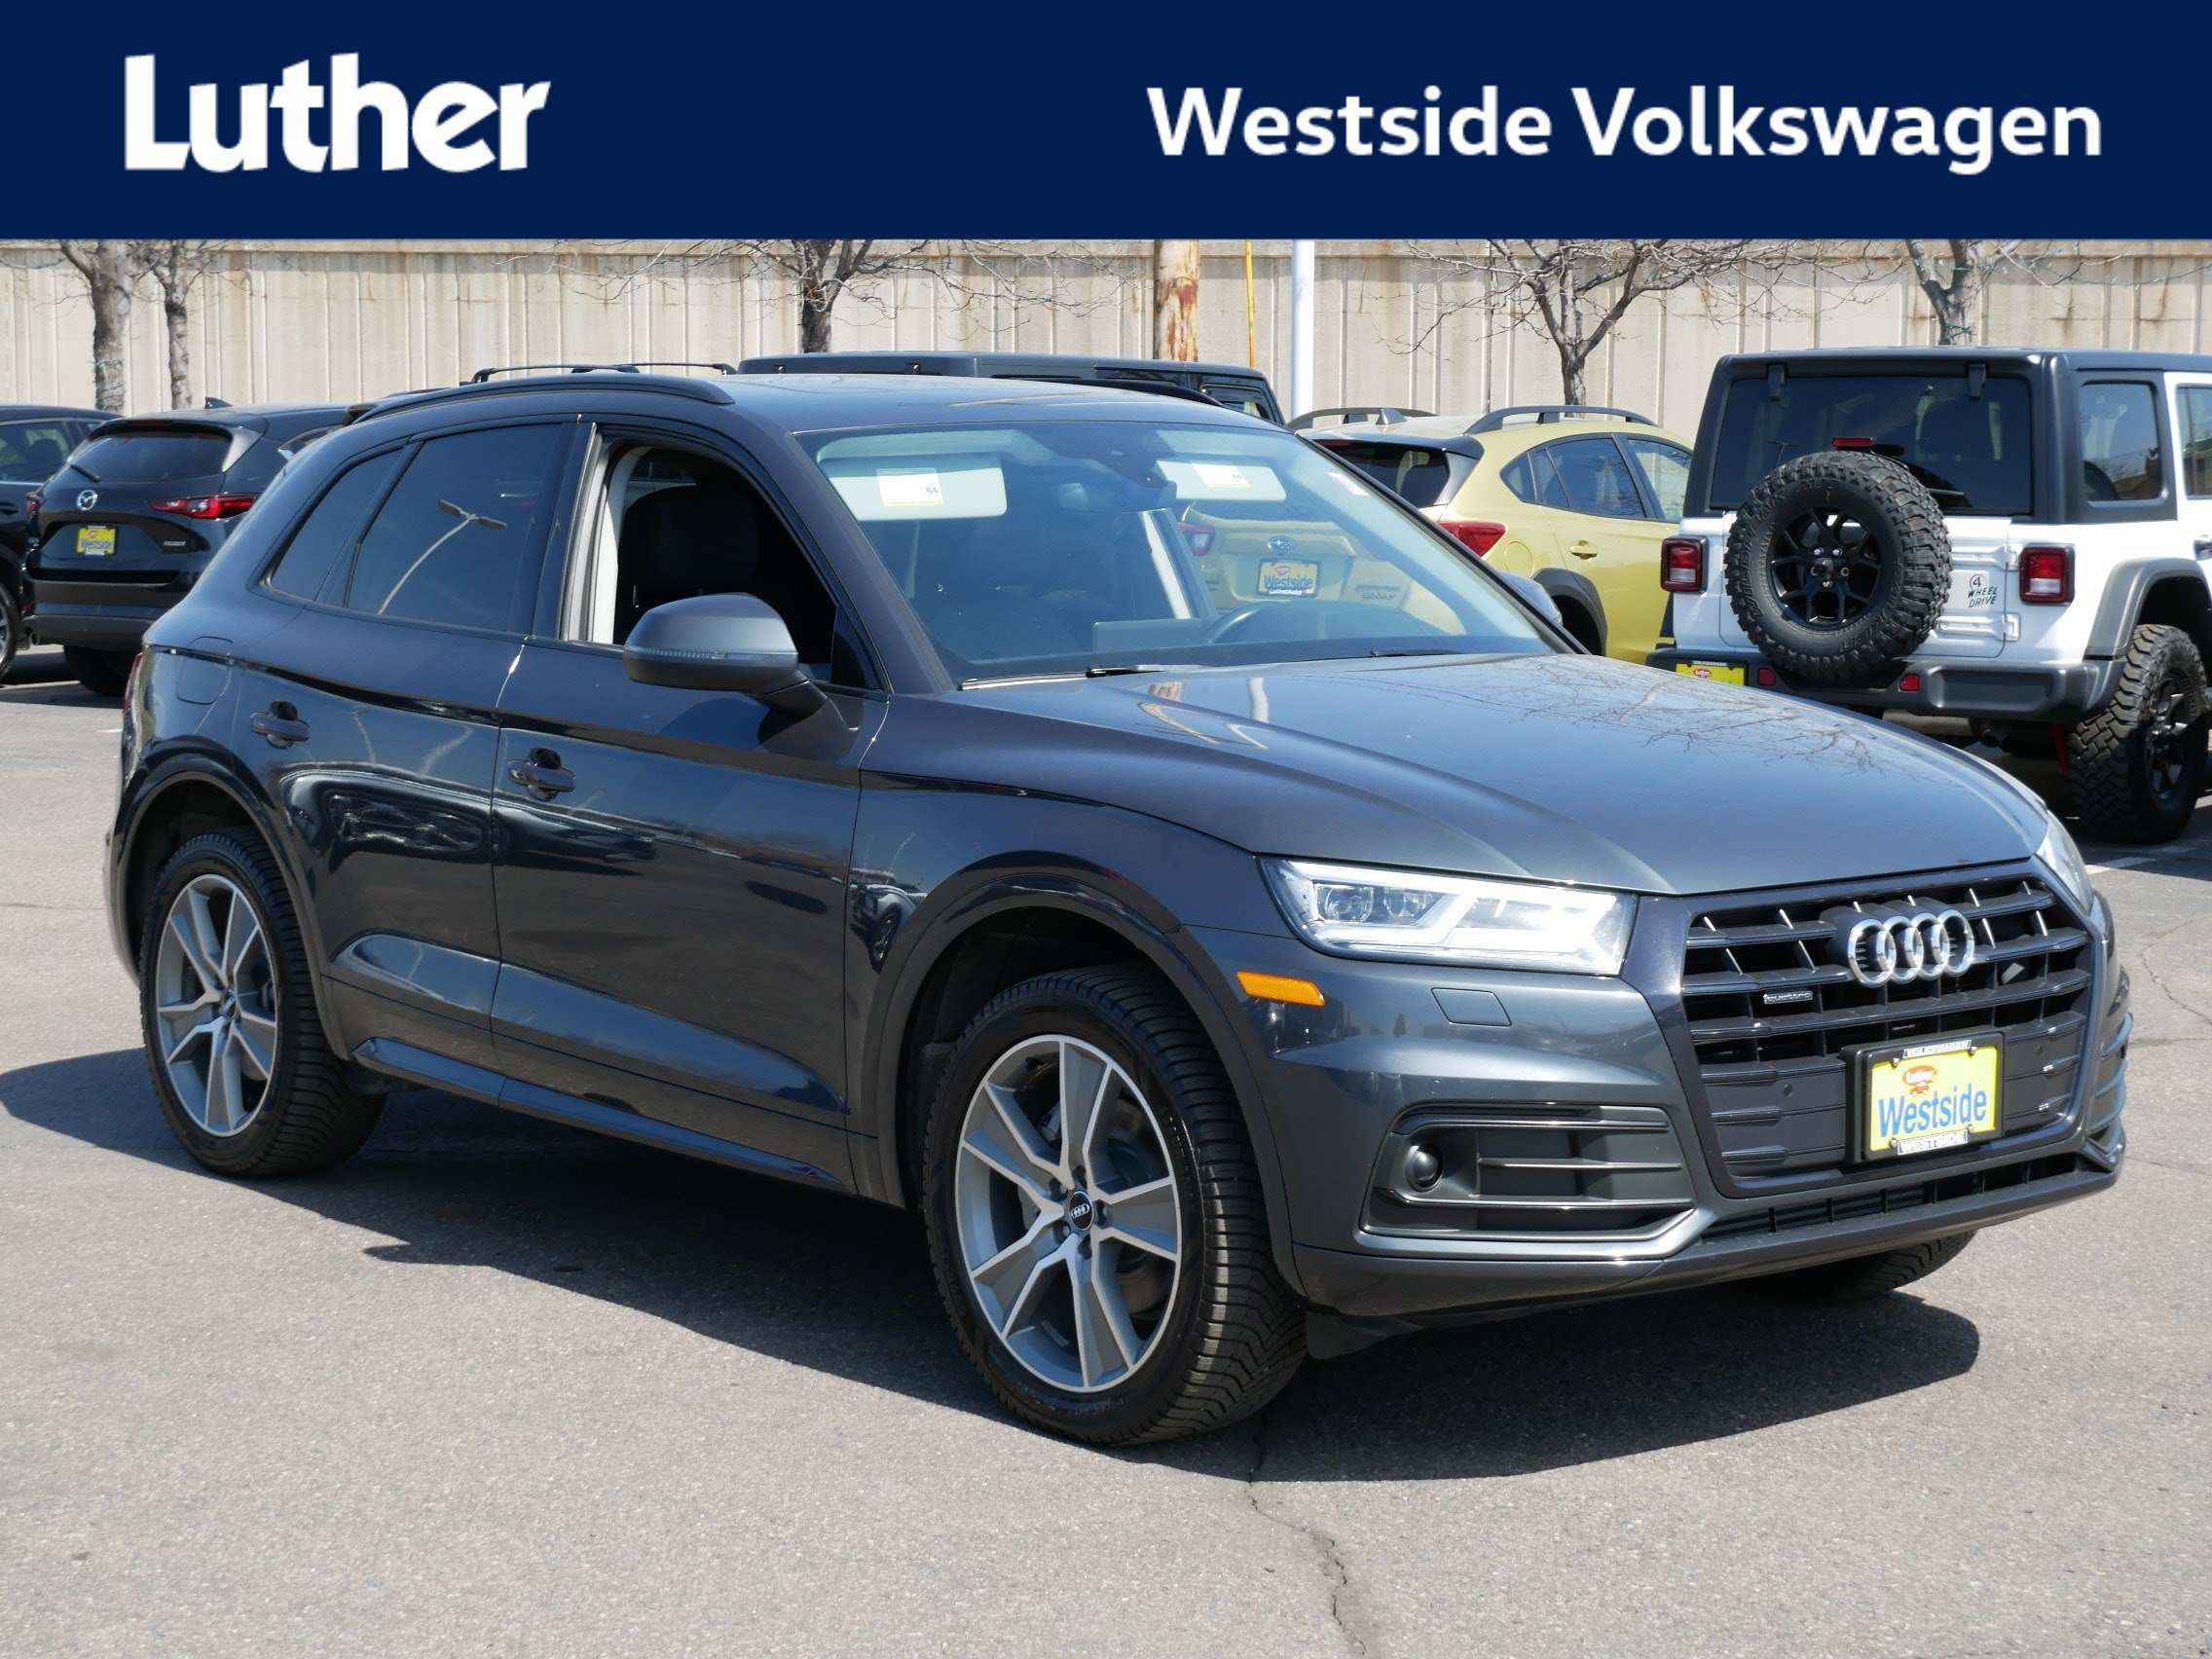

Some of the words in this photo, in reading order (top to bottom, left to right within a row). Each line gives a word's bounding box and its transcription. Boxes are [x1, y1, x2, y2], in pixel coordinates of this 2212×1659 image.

[1264, 574, 1312, 589] Westside
[1972, 576, 1981, 588] 4
[1969, 586, 1998, 599] WHEEL
[1969, 596, 1997, 608] DRIVE
[1878, 1083, 1987, 1137] Westside
